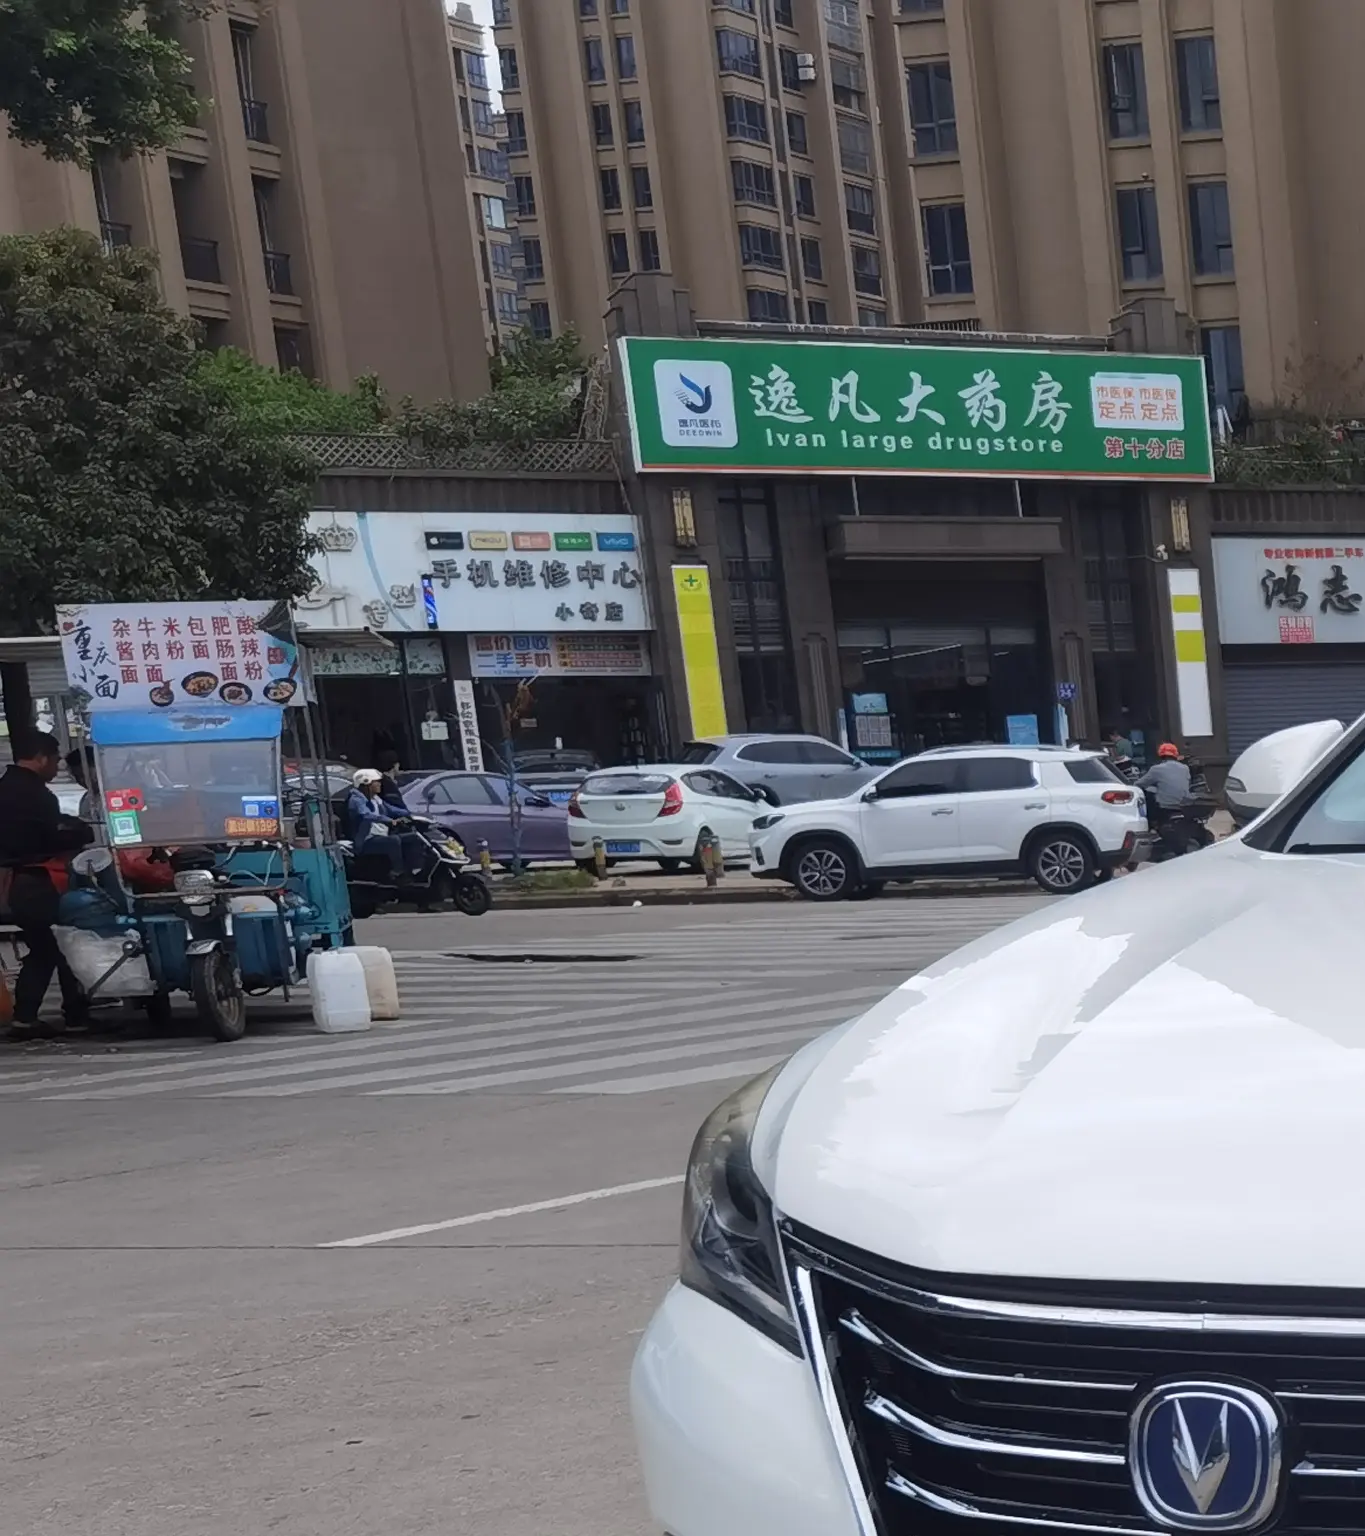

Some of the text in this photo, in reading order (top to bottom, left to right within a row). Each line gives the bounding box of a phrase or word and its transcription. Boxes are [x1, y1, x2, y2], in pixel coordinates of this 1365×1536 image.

[748, 363, 1072, 434] 逸凡大药房
[1098, 402, 1179, 421] 定点 定点
[766, 428, 1064, 455] Ivan large drugstore
[1104, 436, 1185, 459] 第十分店
[431, 558, 640, 590] 手机维修中心
[477, 652, 552, 668] 二手手机
